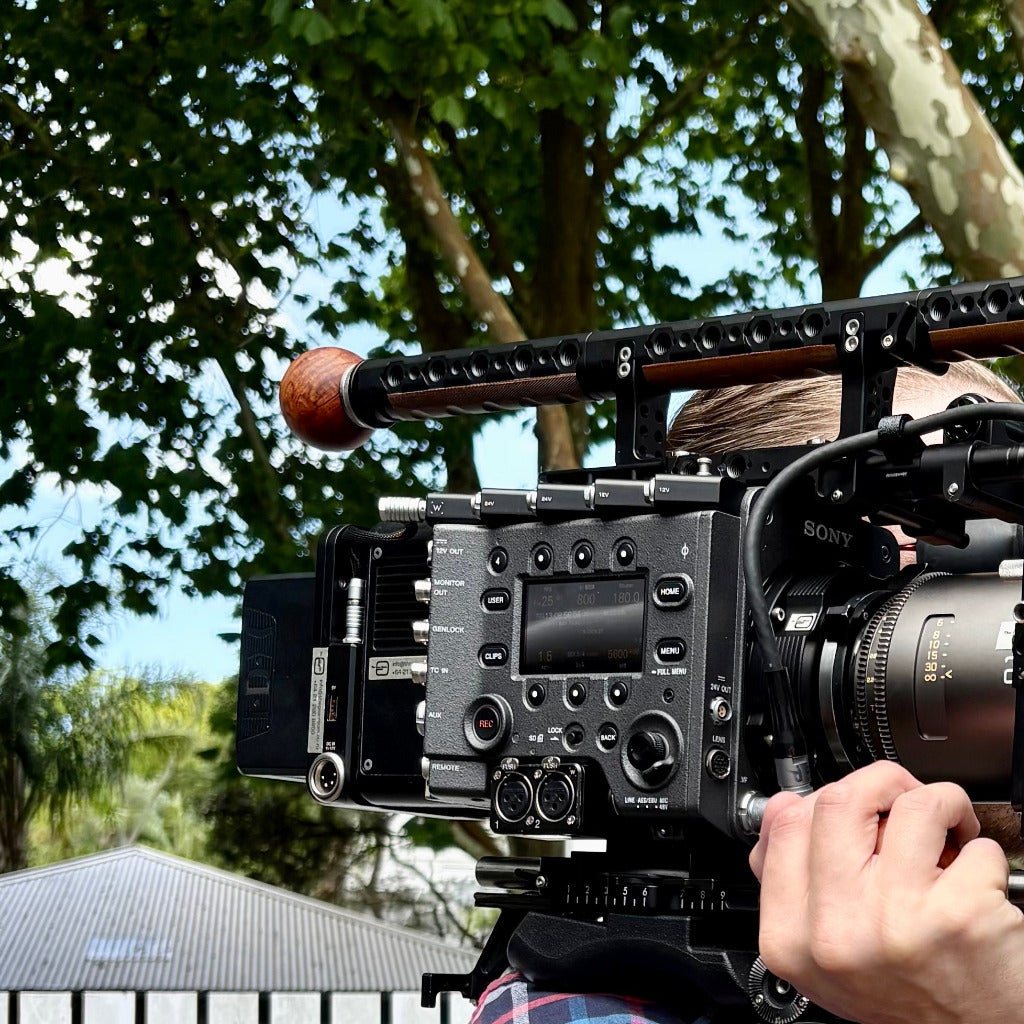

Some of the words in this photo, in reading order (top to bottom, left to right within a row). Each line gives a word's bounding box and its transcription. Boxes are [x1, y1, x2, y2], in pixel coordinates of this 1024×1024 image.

[804, 520, 853, 547] SONY
[660, 587, 680, 596] HOME
[487, 596, 504, 604] USER
[613, 591, 640, 604] 180.0
[936, 618, 943, 627] 6
[432, 625, 465, 633] GENLOCK
[932, 630, 940, 639] 8
[929, 640, 940, 649] 10
[660, 647, 680, 655] MENU
[927, 651, 938, 660] 15
[484, 652, 502, 660] CLIPS
[430, 666, 440, 674] TC
[924, 662, 938, 672] 30
[656, 668, 670, 676] FULL
[710, 683, 721, 691] 24V
[721, 685, 732, 694] OUT
[479, 719, 494, 728] REC
[547, 726, 563, 734] LOCK
[528, 734, 537, 742] SD
[712, 735, 726, 743] LENS
[431, 763, 460, 771] REMOTE
[494, 820, 499, 829] 1
[534, 820, 541, 829] 2
[585, 886, 590, 894] 2
[622, 886, 628, 895] 5
[642, 887, 647, 896] 6
[700, 891, 706, 899] 8
[720, 891, 726, 900] 9
